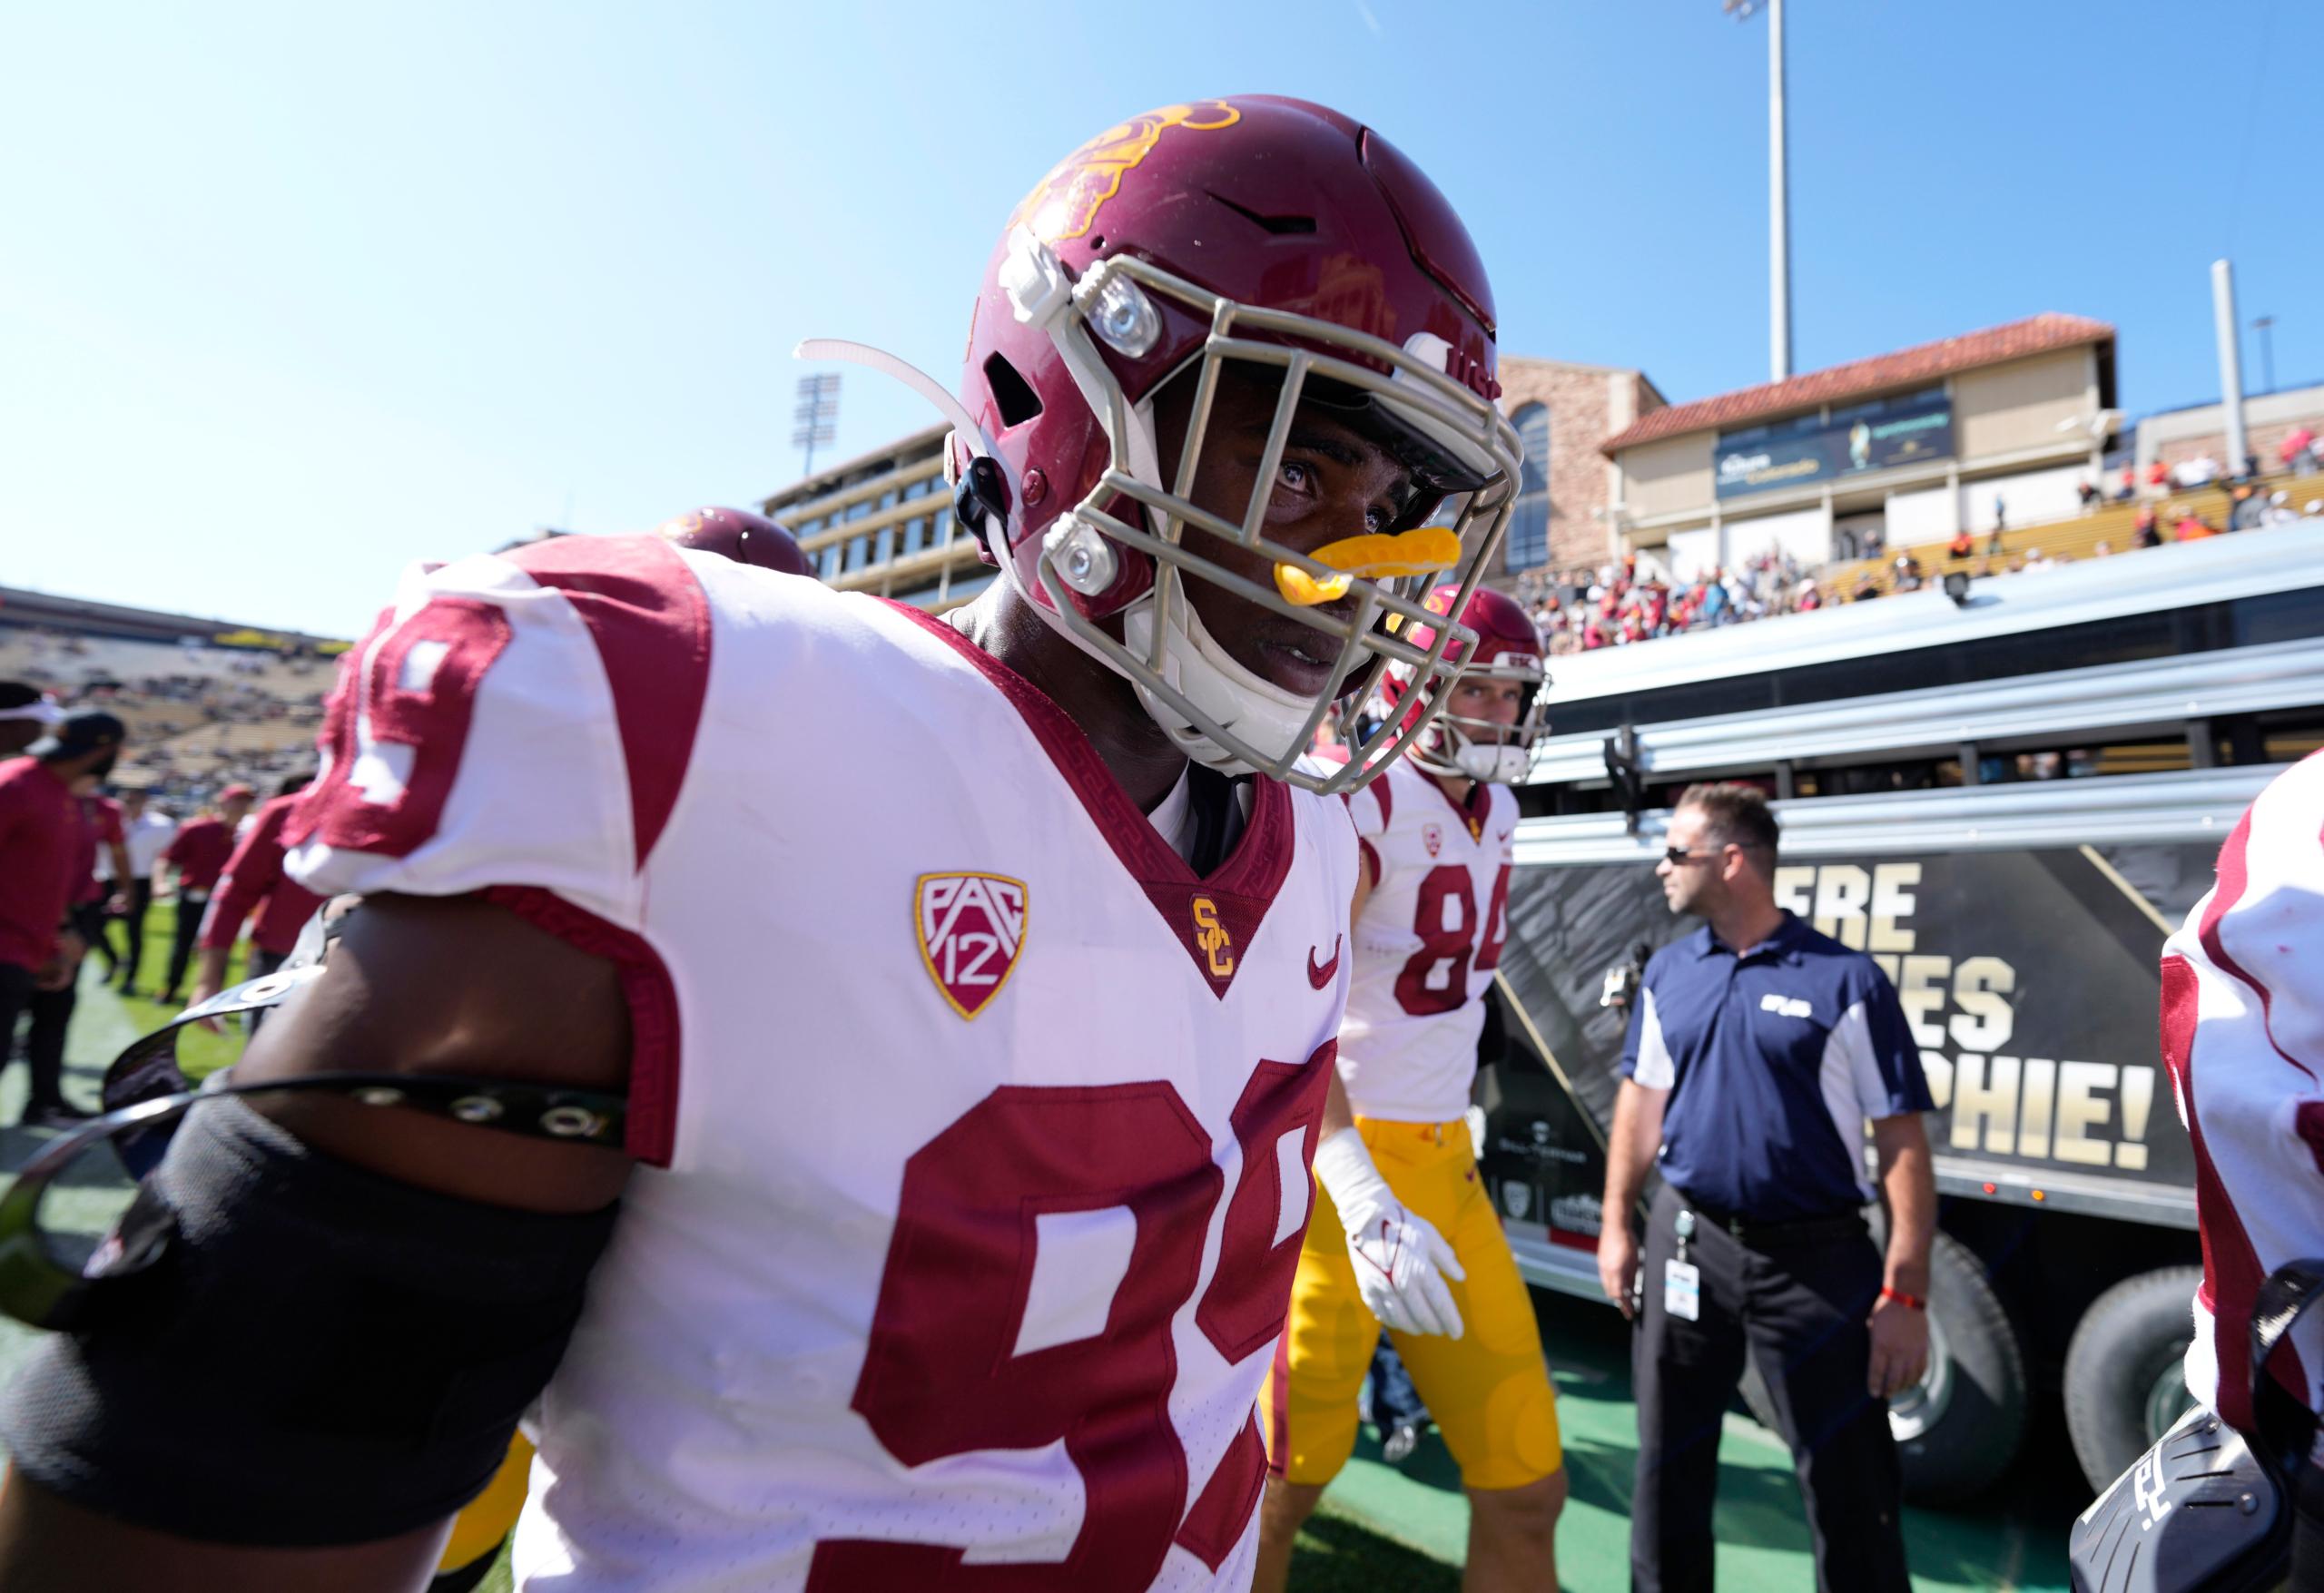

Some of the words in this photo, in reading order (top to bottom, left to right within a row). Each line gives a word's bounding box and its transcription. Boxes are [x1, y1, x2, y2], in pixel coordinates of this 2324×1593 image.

[922, 877, 1024, 959] PAC
[1774, 862, 1922, 952] ERE
[944, 932, 1000, 986] 12
